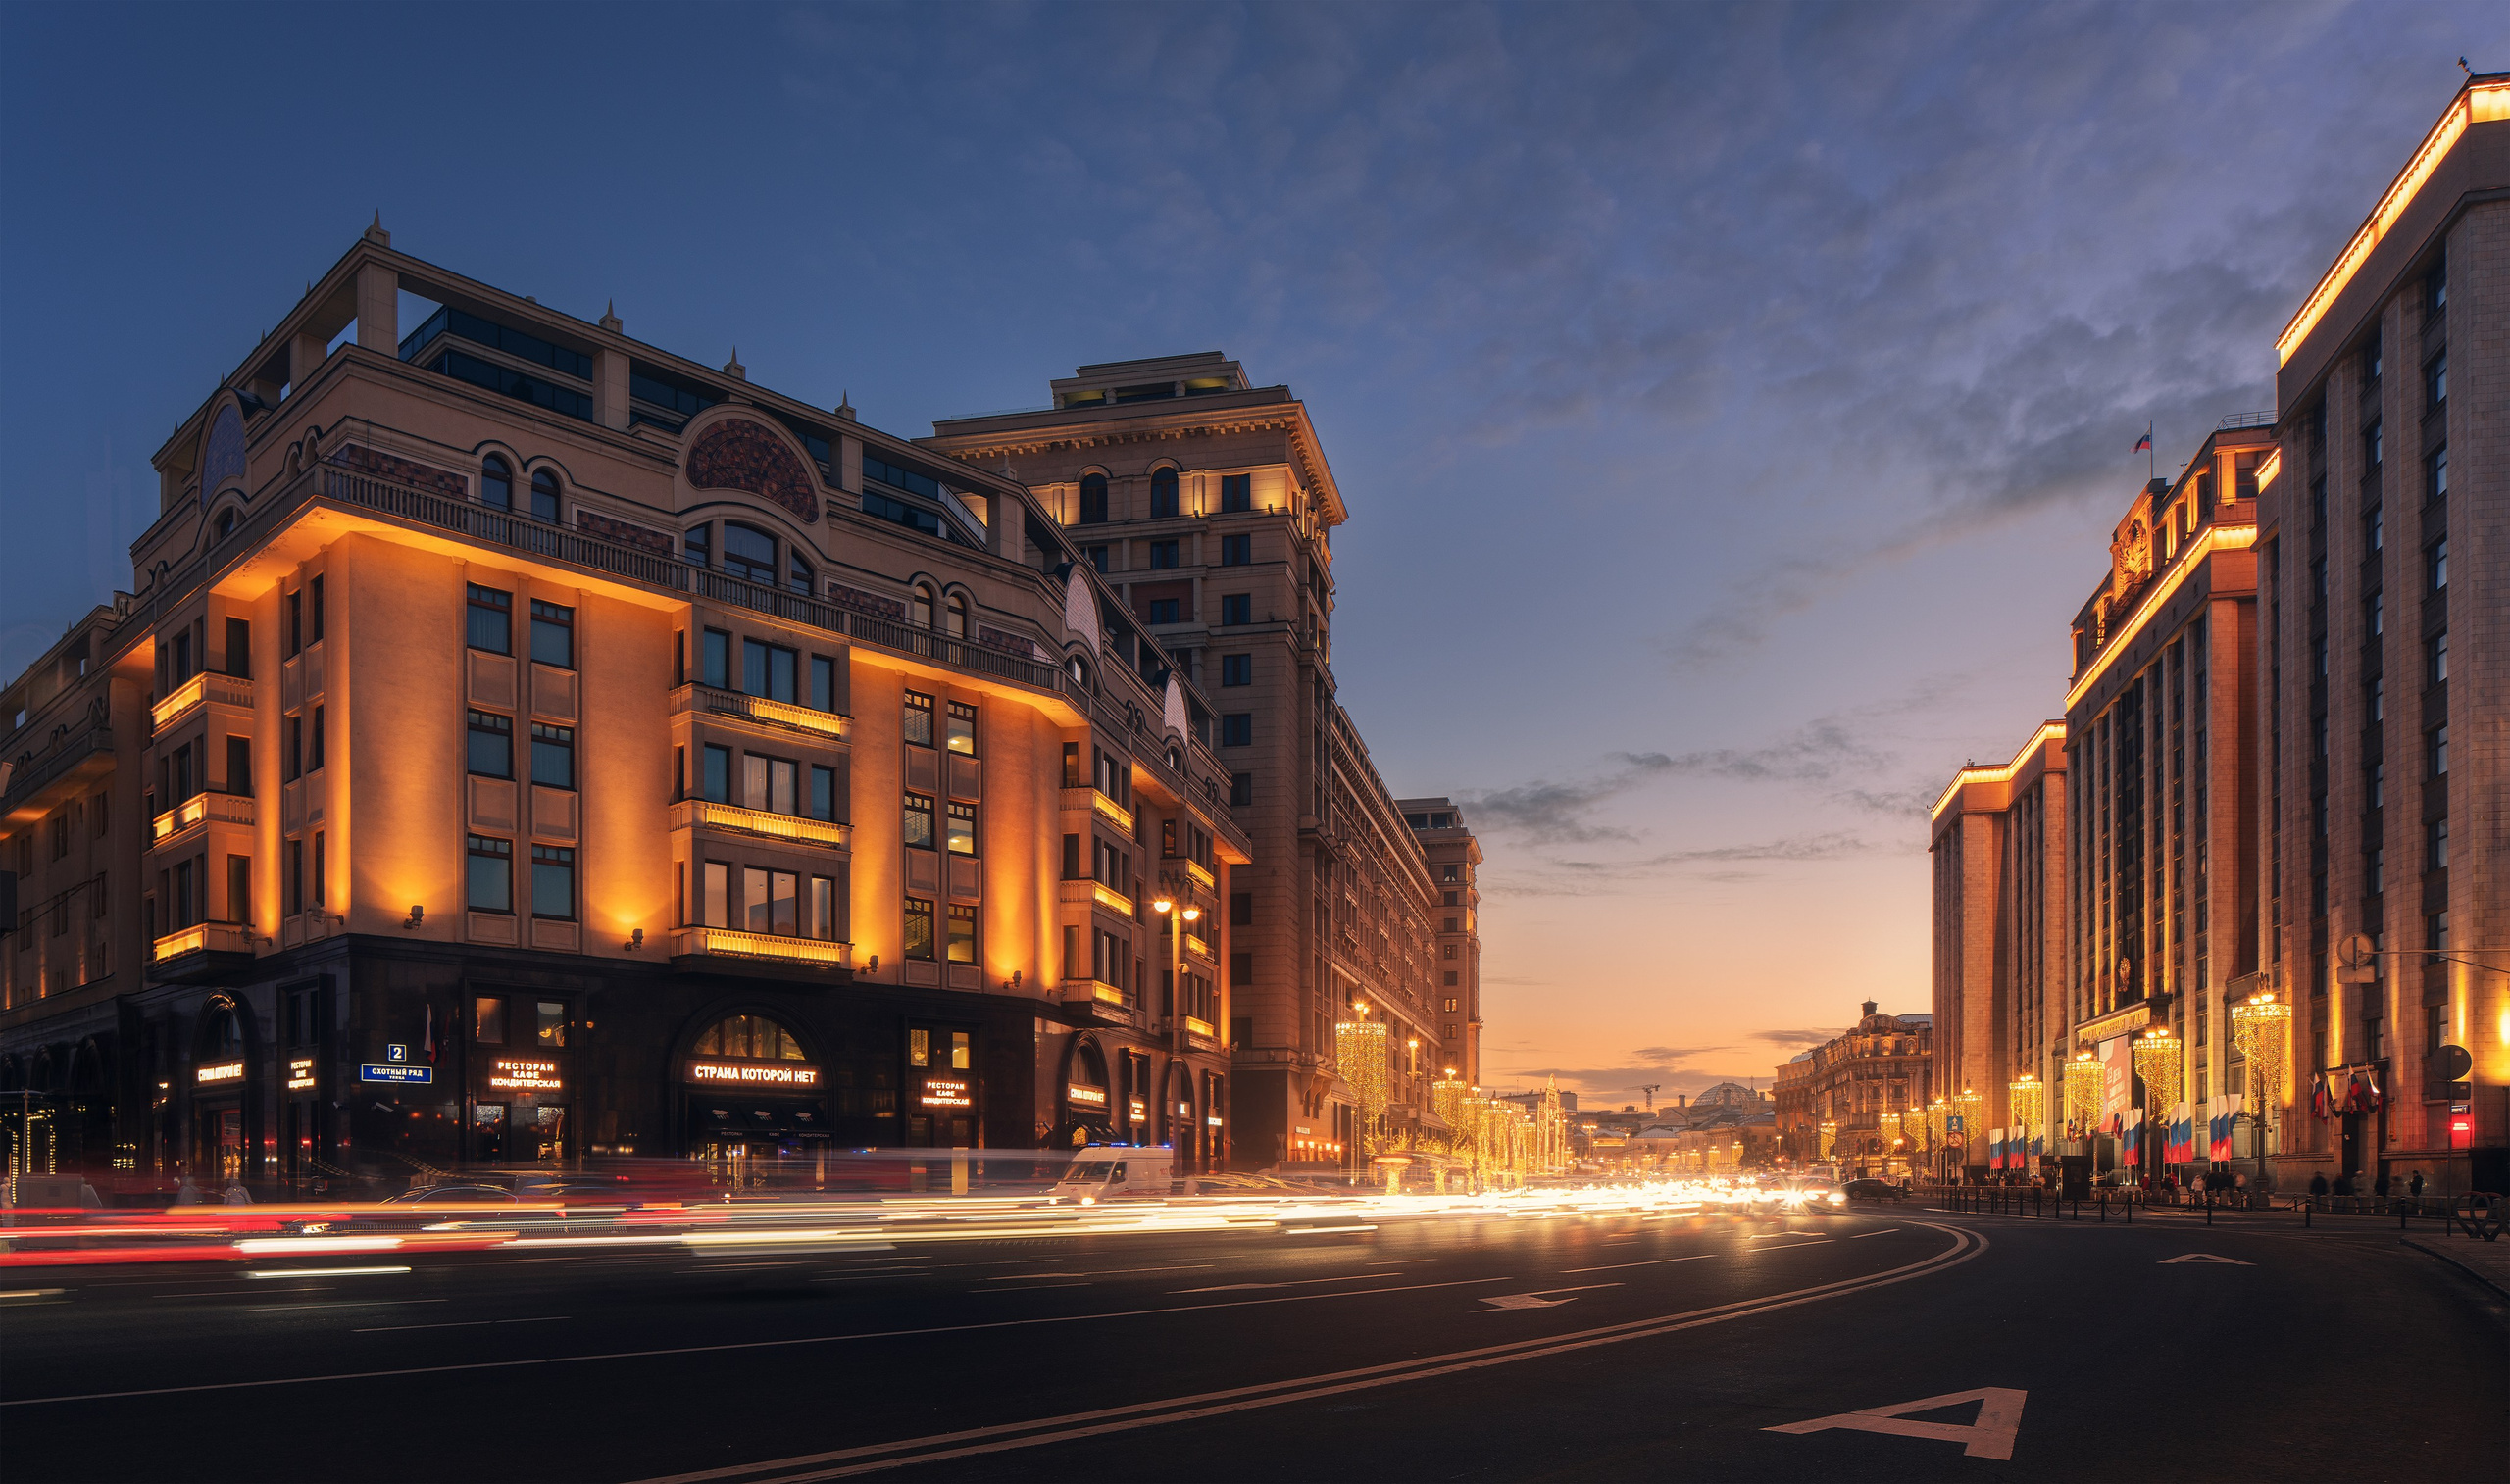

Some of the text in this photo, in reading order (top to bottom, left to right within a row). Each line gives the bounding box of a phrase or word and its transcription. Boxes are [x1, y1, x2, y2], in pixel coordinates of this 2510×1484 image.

[393, 1047, 402, 1059] 2
[498, 1062, 554, 1071] РЕСТОРАН
[372, 1067, 424, 1077] ОХОТНЫЙ РЯД
[512, 1070, 540, 1079] КАФЕ
[695, 1065, 816, 1083] СТРАНА КОТОРОЙ НЕТ
[491, 1077, 561, 1088] КОНДИТЕРСКАЯ
[927, 1081, 965, 1090] РЕСТОРАН
